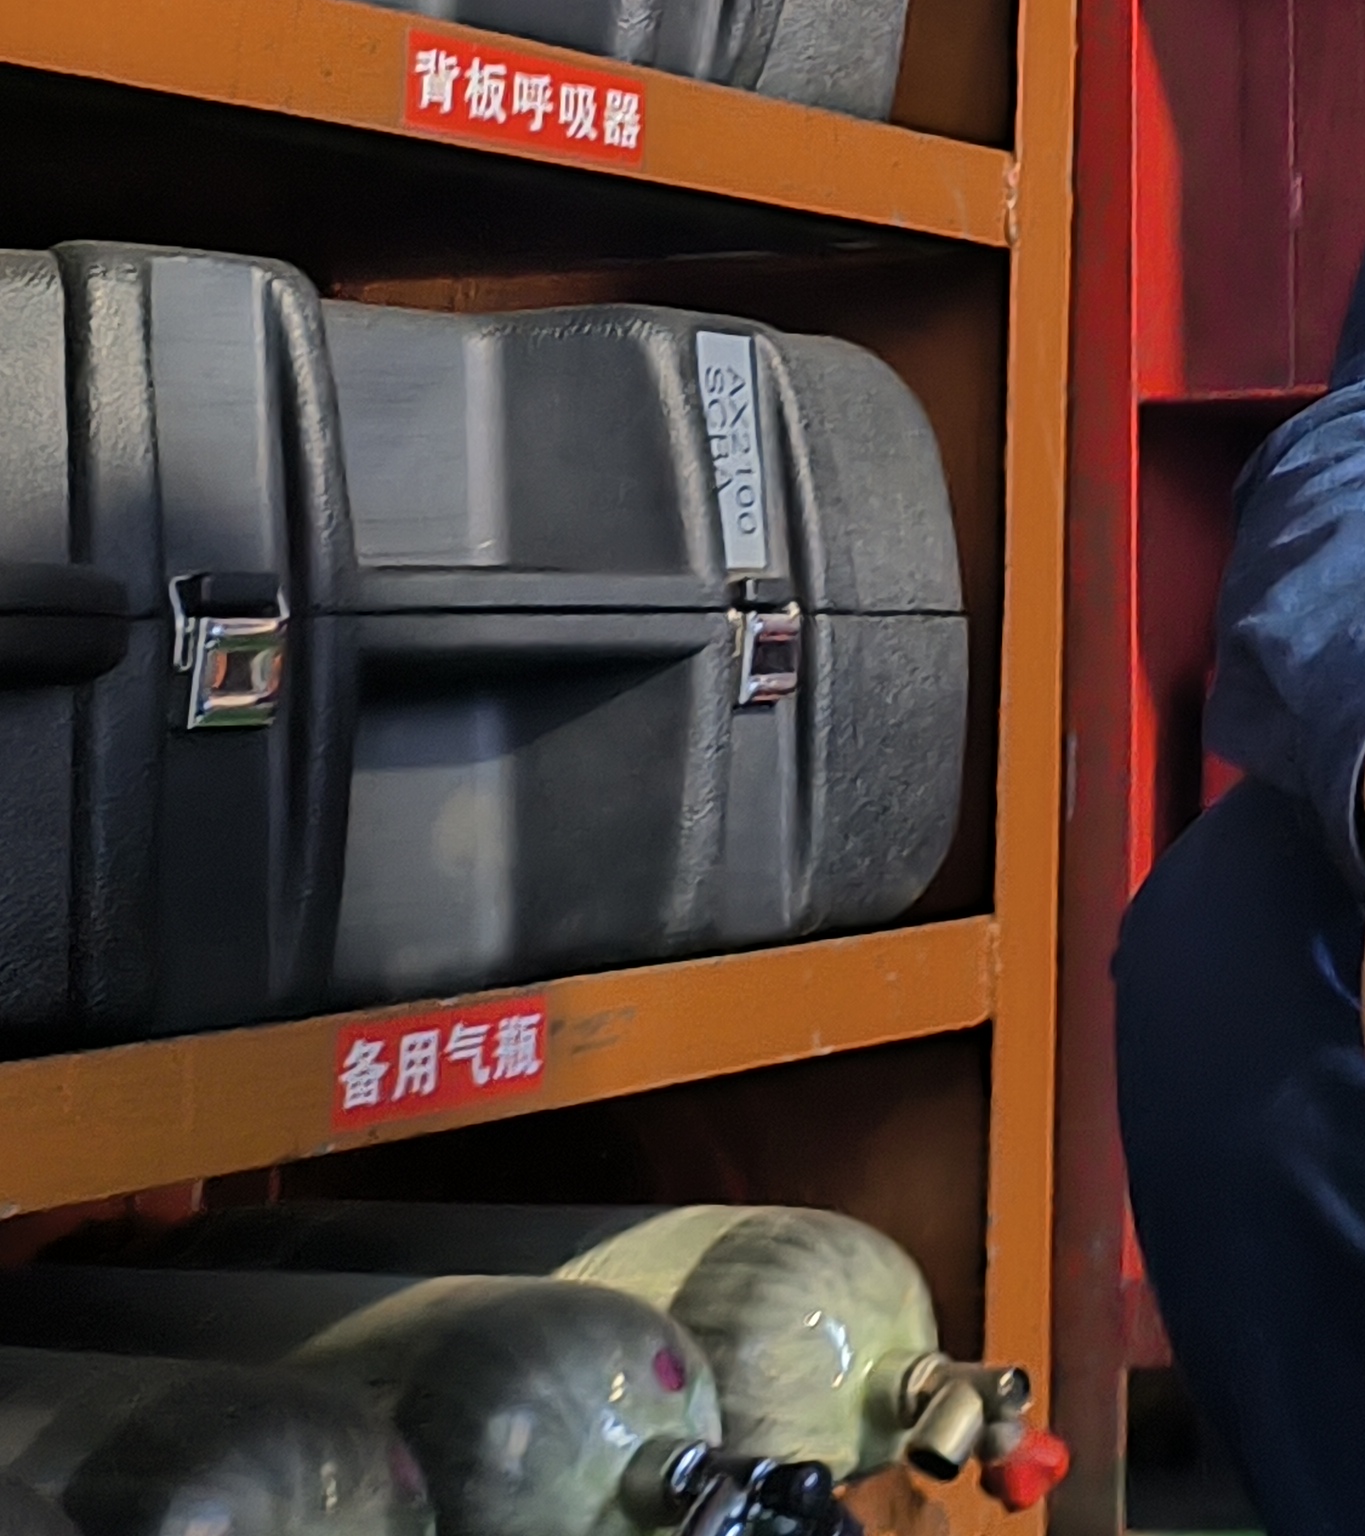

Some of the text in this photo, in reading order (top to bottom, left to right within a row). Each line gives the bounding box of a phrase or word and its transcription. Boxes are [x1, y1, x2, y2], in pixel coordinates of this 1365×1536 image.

[415, 49, 640, 149] 背板呼吸器
[705, 365, 732, 494] SCBA
[727, 366, 757, 535] AX2100
[339, 1013, 543, 1109] 备用气瓶
